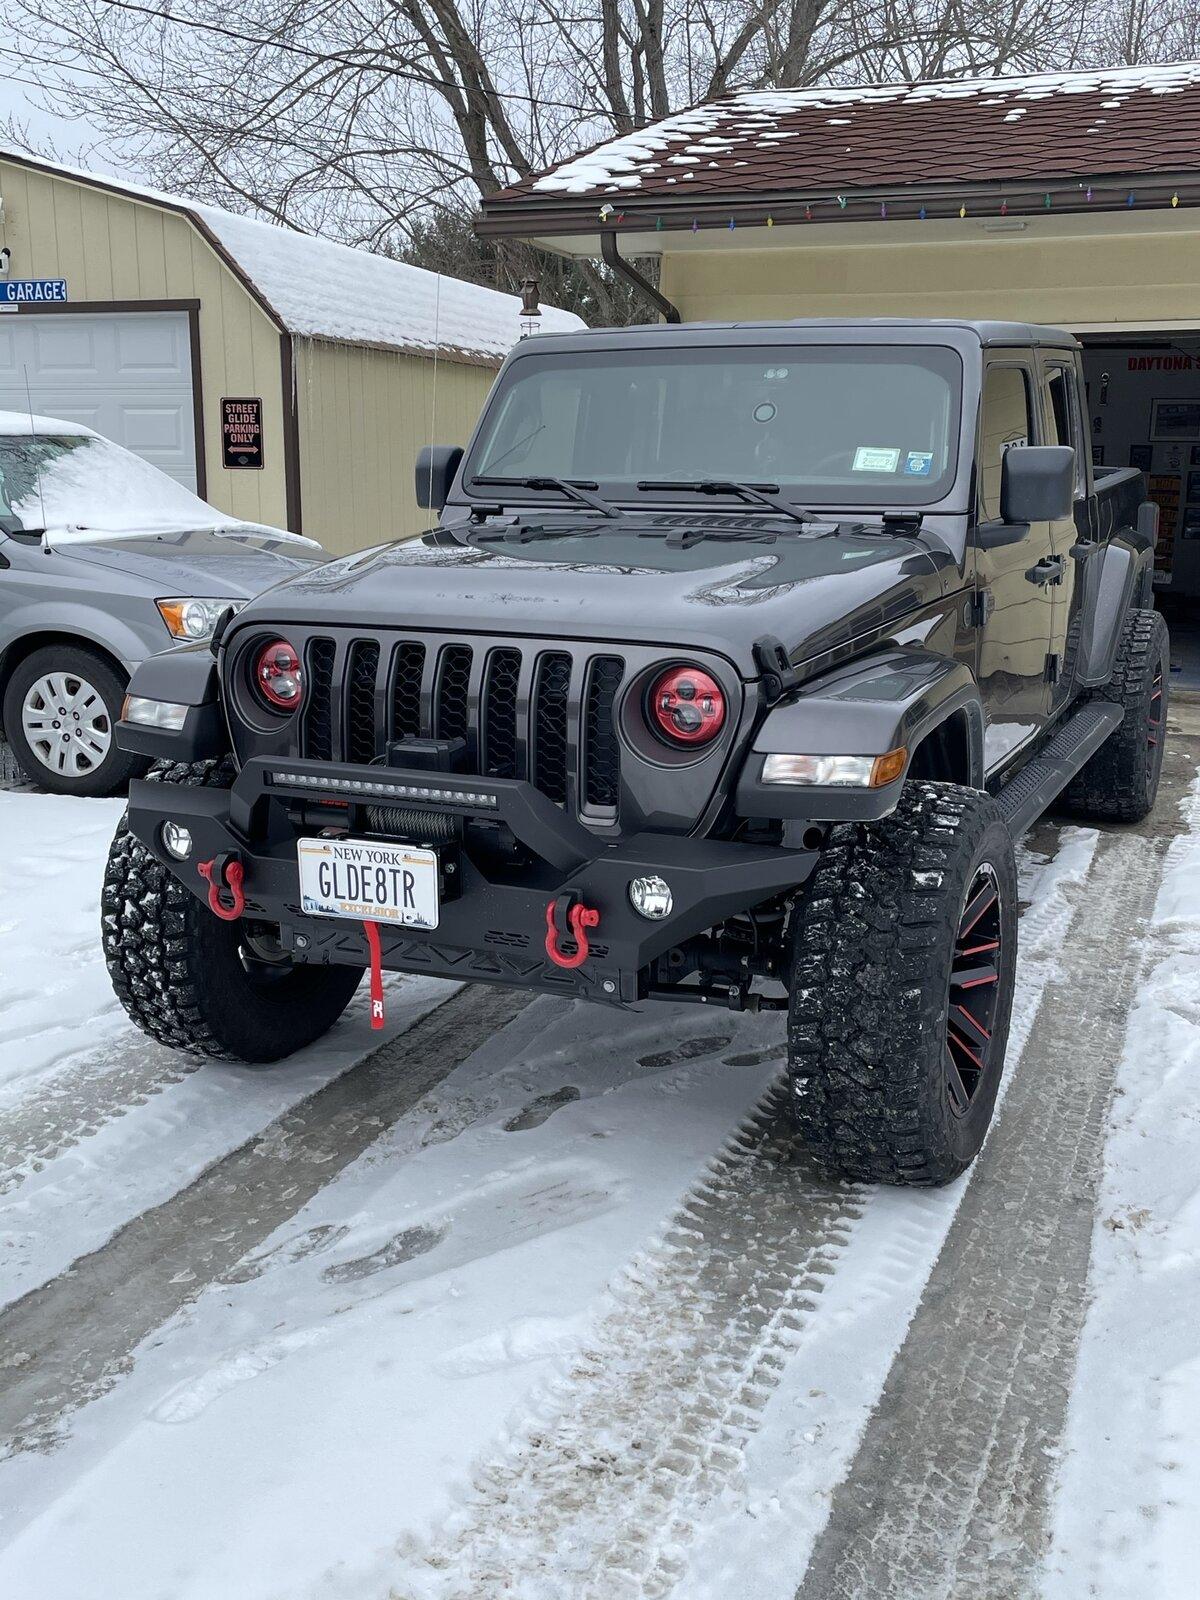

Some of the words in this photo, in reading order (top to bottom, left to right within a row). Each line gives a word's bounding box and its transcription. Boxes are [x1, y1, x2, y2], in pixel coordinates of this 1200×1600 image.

[6, 282, 62, 301] GARAGE
[1128, 355, 1192, 371] DAYTONA
[225, 403, 258, 414] STREET
[228, 413, 256, 424] GLIDE
[224, 423, 260, 434] PARKING
[230, 433, 254, 443] ONLY
[334, 846, 363, 862] NEW
[368, 850, 400, 866] YORK
[319, 861, 415, 908] GLDE8TR
